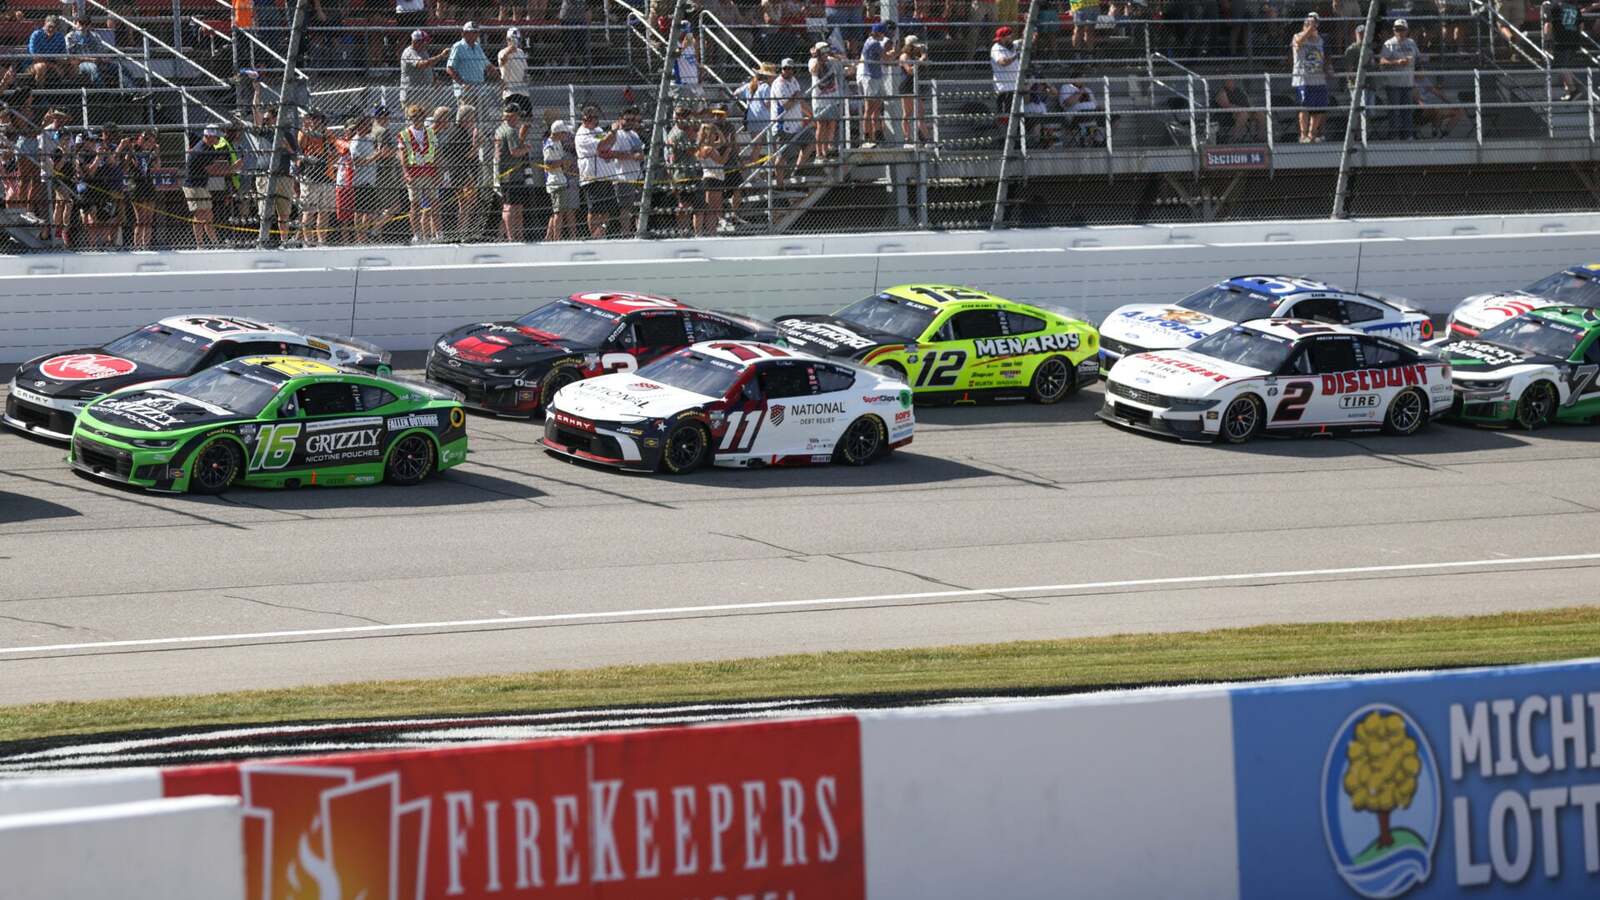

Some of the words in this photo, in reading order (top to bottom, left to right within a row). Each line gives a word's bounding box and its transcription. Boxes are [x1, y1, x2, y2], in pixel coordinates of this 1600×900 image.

[1208, 153, 1247, 165] SECTION
[1251, 153, 1261, 164] 14
[181, 336, 196, 344] BELL
[975, 334, 1080, 357] MENARDS
[915, 350, 967, 387] 12
[1321, 365, 1428, 396] DISCOUNT
[1565, 364, 1600, 406] 7
[791, 402, 846, 416] NATIONAL
[1271, 381, 1314, 422] 2
[1343, 395, 1376, 408] TIRE
[387, 418, 409, 430] FALLEN
[409, 414, 439, 427] OUTDOORS
[556, 416, 591, 430] CAMRY
[719, 410, 763, 450] 11
[249, 423, 302, 471] 16
[306, 429, 382, 453] GRIZZLY
[306, 454, 339, 463] NICOTINE
[341, 449, 380, 459] POUCHES
